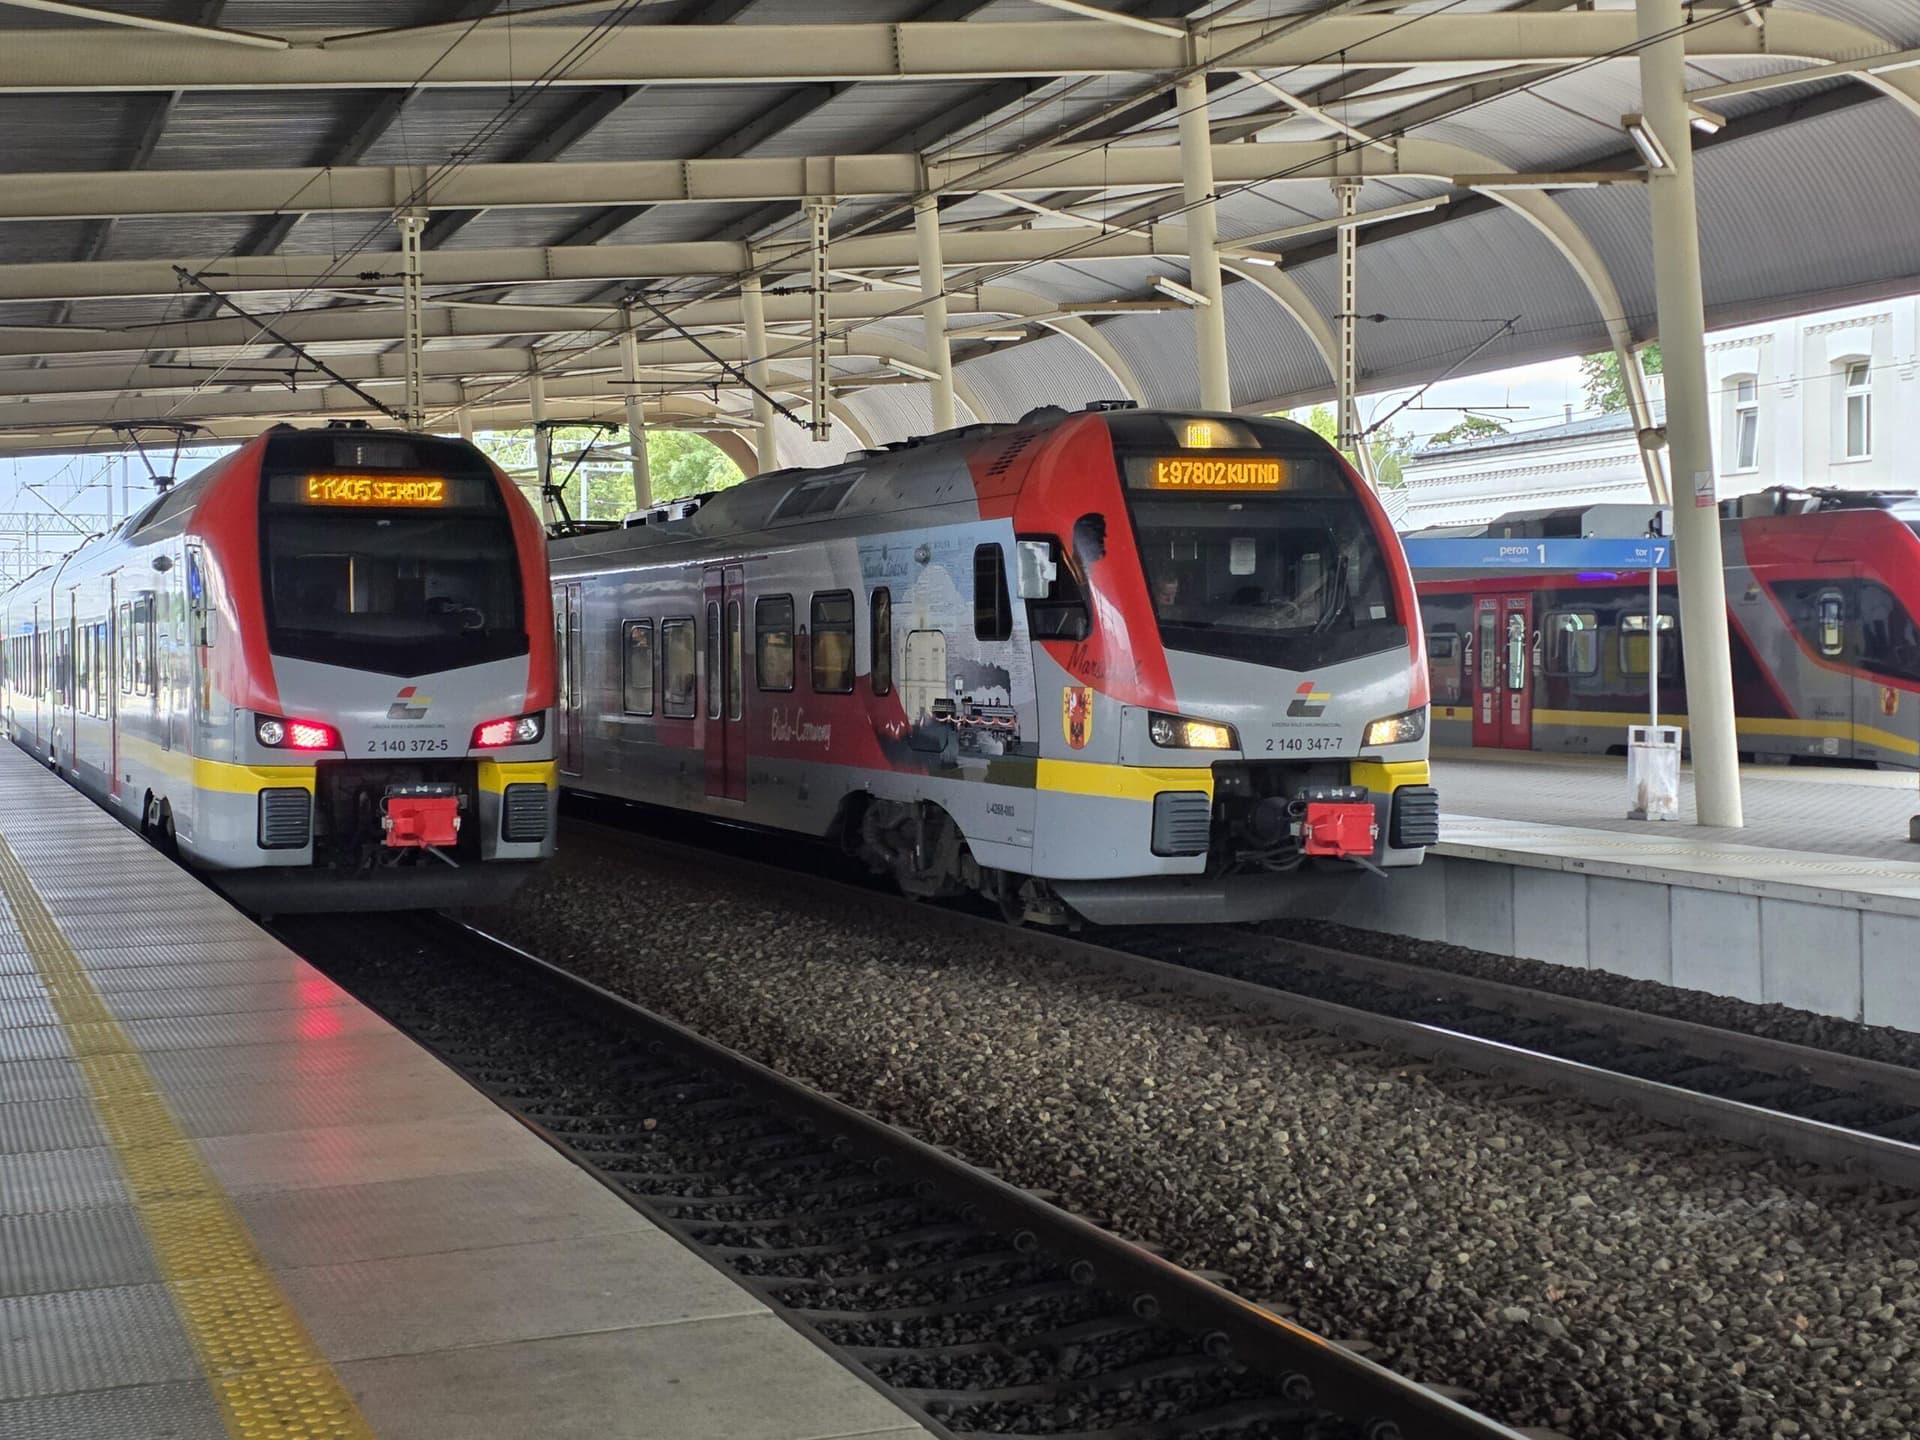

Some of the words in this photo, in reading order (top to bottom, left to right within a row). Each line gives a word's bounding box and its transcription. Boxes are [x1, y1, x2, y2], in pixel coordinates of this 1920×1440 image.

[1158, 461, 1227, 485] Ł97802
[1227, 463, 1279, 484] KUTNO
[1500, 545, 1529, 556] peron
[1536, 544, 1546, 564] 1
[1635, 548, 1648, 557] tor
[1654, 547, 1665, 564] 7
[1465, 631, 1473, 652] 2
[1533, 630, 1541, 651] 2
[367, 740, 376, 752] 2
[381, 740, 406, 752] 140
[410, 739, 448, 752] 372-5
[1265, 738, 1274, 751] 2
[1279, 738, 1303, 751] 140
[1306, 737, 1343, 751] 347-7
